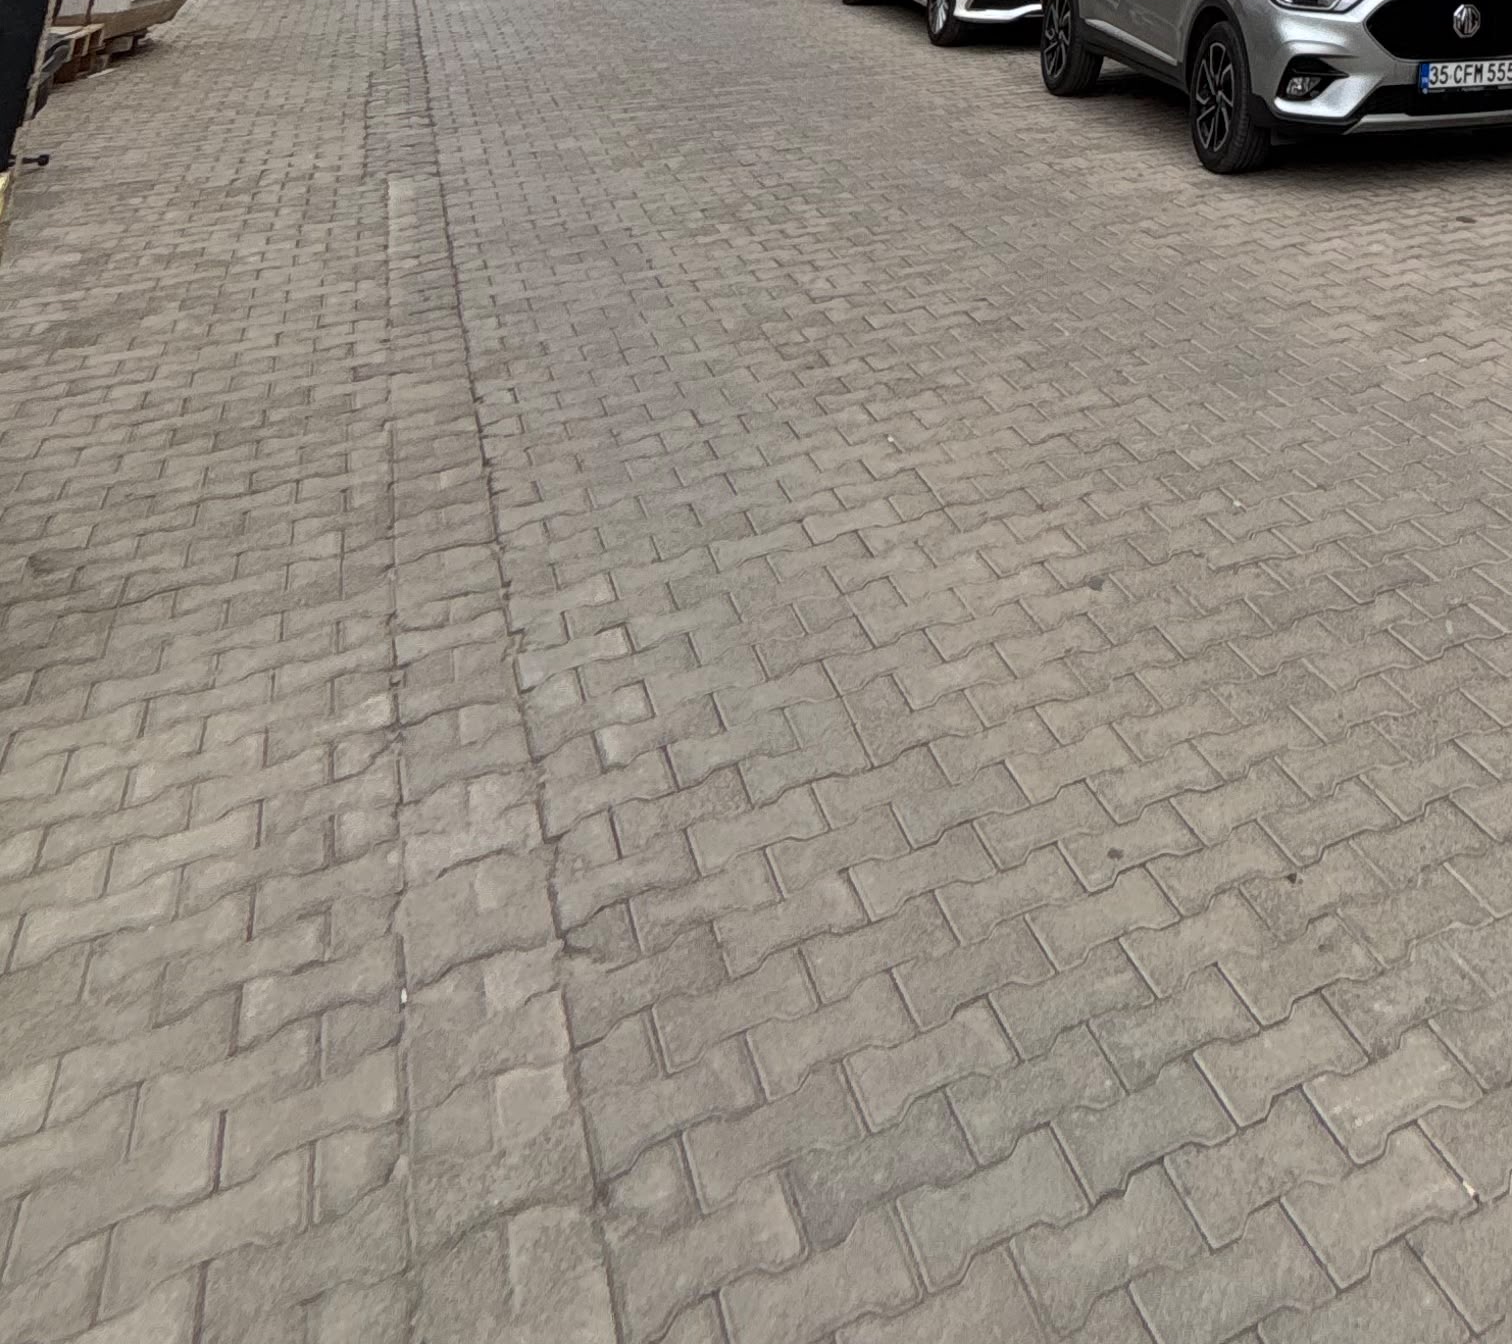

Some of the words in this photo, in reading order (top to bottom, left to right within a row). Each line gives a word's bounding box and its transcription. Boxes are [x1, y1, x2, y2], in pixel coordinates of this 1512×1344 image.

[1456, 6, 1479, 35] MG
[1430, 65, 1449, 85] 35
[1453, 63, 1484, 84] CFM
